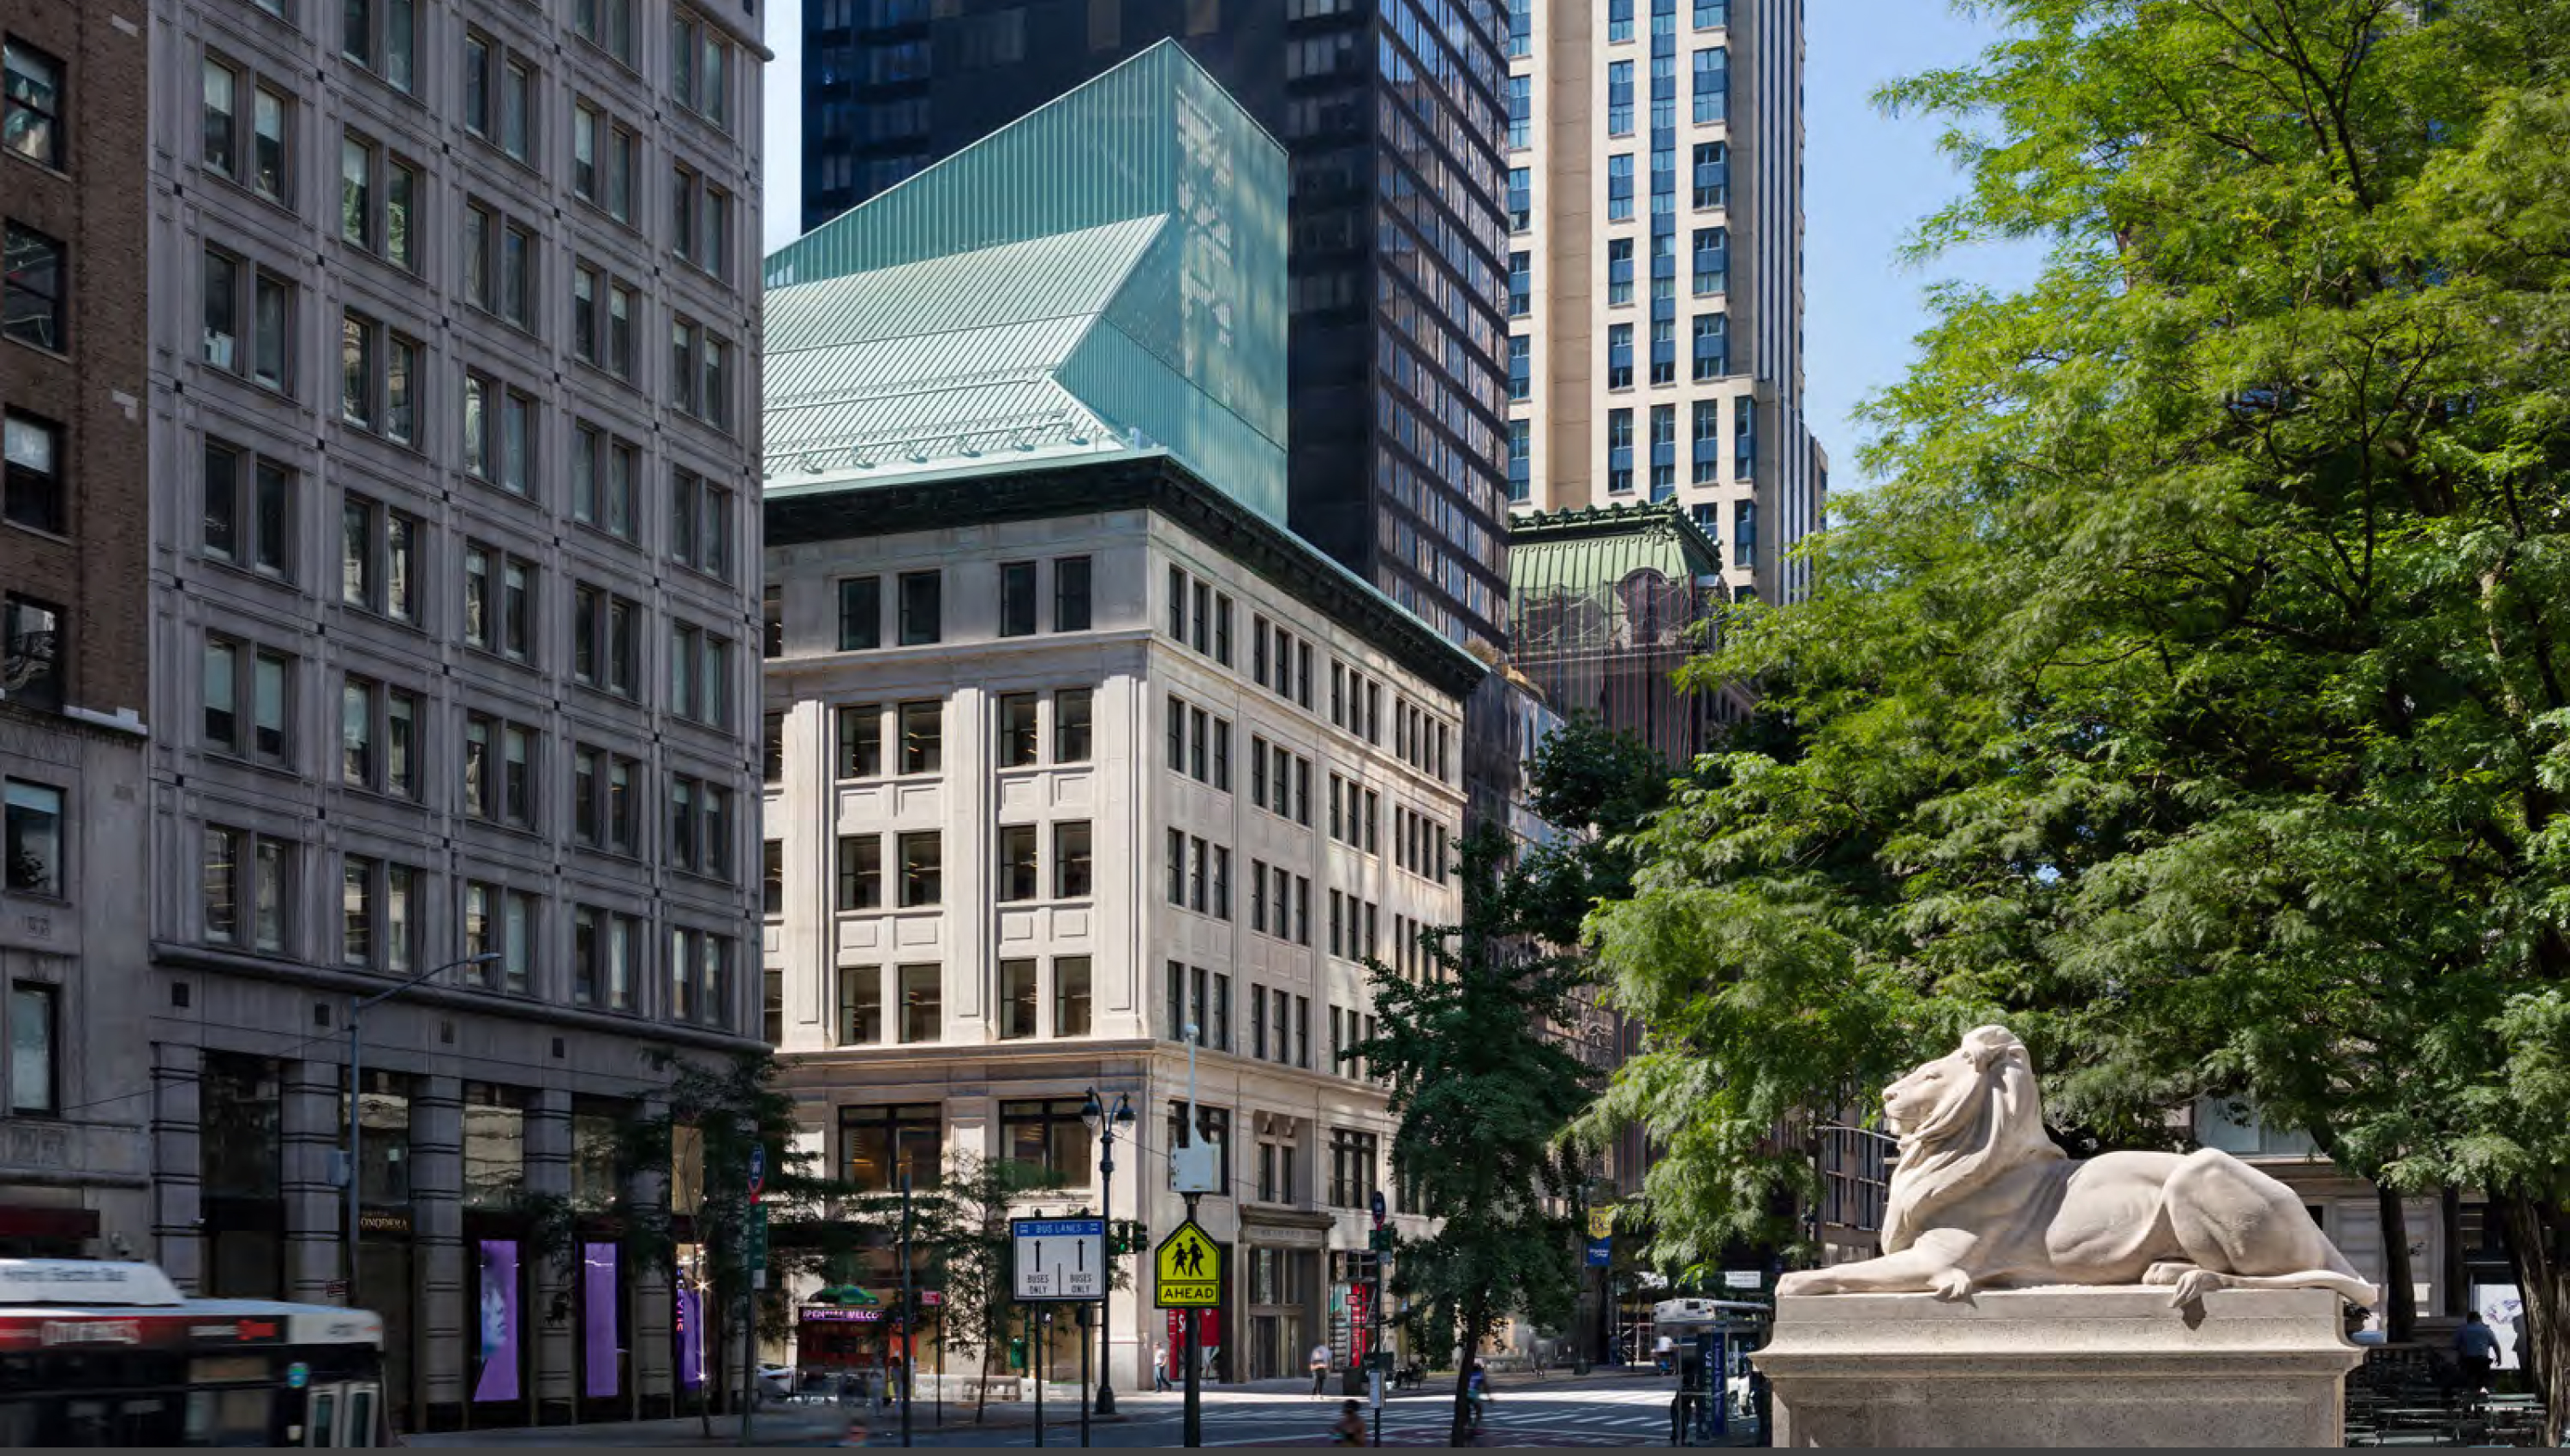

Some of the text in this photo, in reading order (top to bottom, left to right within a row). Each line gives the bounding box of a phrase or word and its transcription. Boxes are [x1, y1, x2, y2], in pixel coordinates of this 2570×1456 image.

[1036, 1223, 1082, 1234] BUS LANES
[1027, 1274, 1049, 1284] BUSES
[1069, 1274, 1092, 1284] BUSES
[1029, 1285, 1048, 1295] ONLY
[1071, 1285, 1091, 1294] ONLY
[1164, 1286, 1215, 1300] AHEAD
